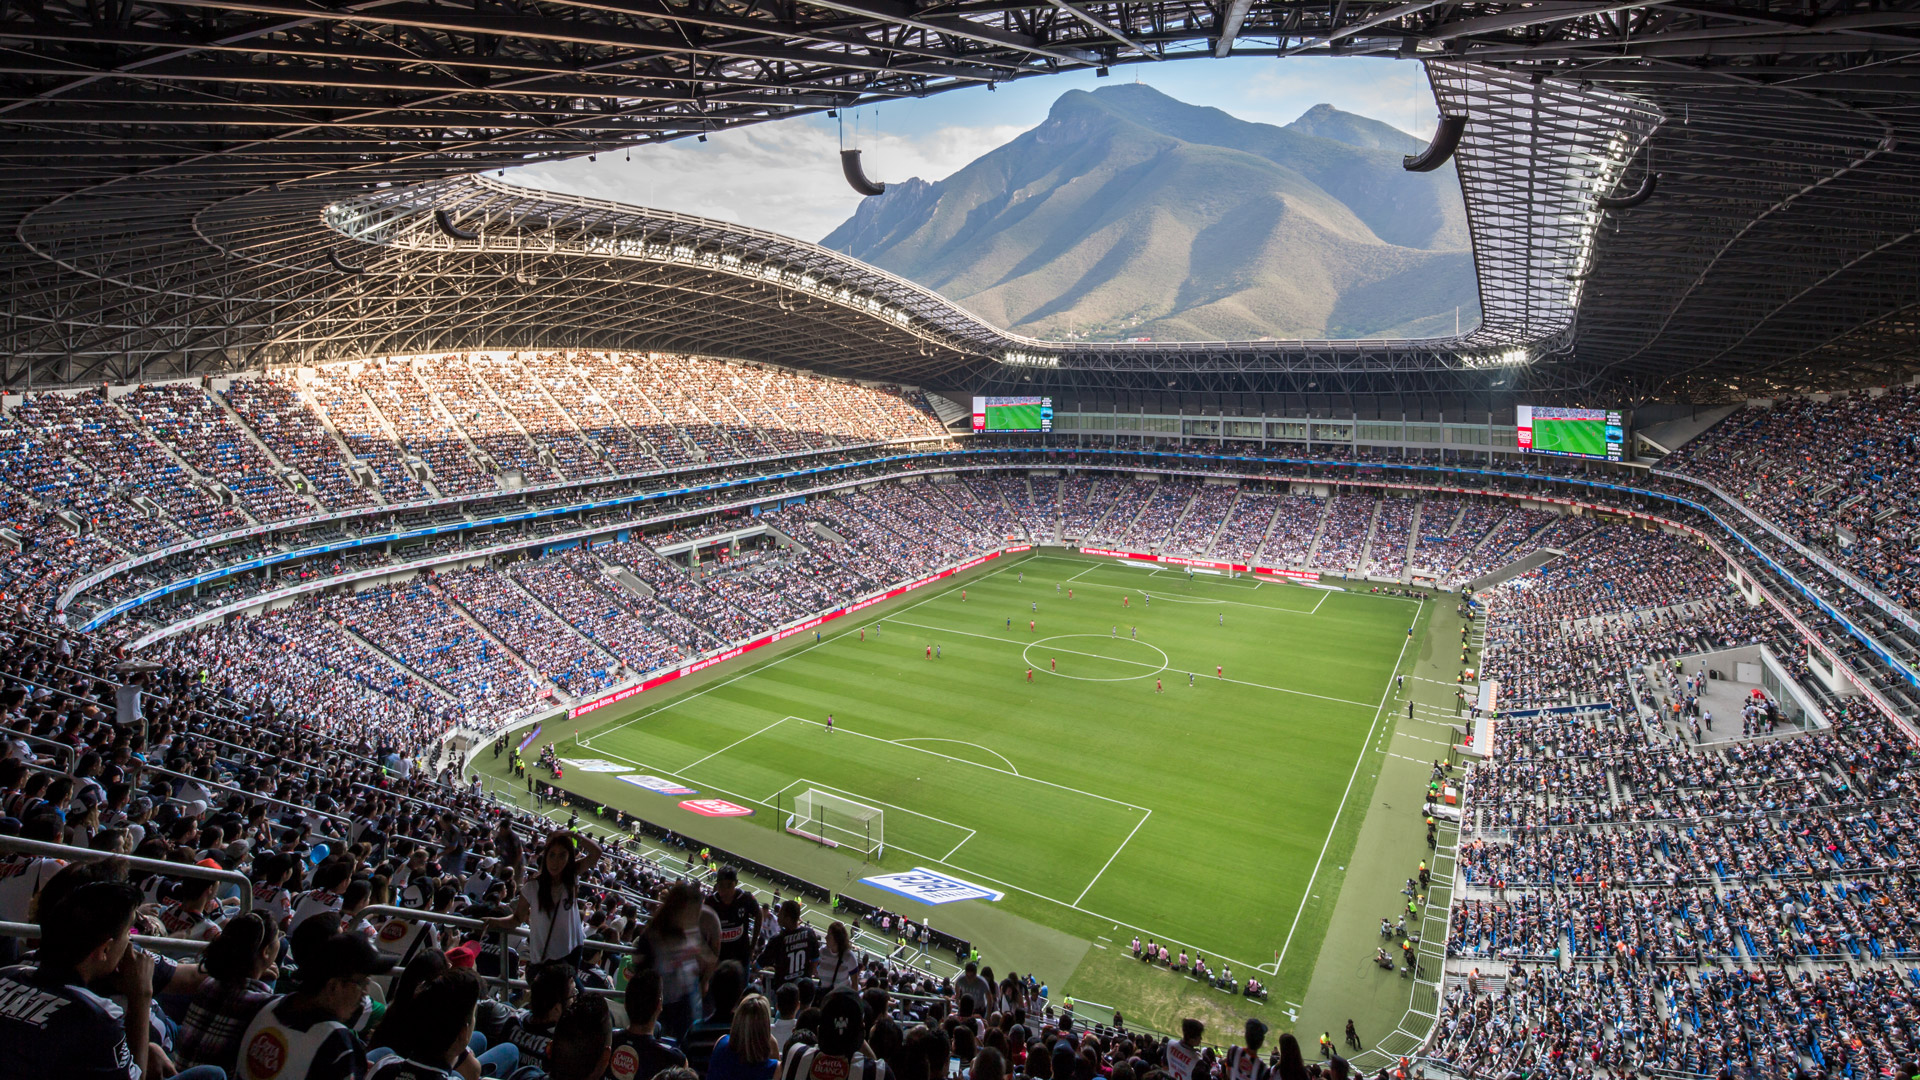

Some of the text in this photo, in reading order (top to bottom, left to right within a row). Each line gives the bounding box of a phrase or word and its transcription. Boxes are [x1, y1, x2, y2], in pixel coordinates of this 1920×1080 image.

[578, 701, 598, 715] siempre
[600, 696, 614, 708] listos,
[616, 688, 635, 701] siempre
[720, 928, 742, 940] MBO
[784, 930, 808, 944] TECATE
[788, 950, 806, 974] 10
[509, 1025, 552, 1053] TECATE
[616, 1052, 634, 1064] CARTA
[1170, 1046, 1192, 1066] TECATE
[614, 1056, 635, 1071] BLANCA
[814, 1065, 844, 1076] BLANCA
[818, 1059, 842, 1068] CARTA
